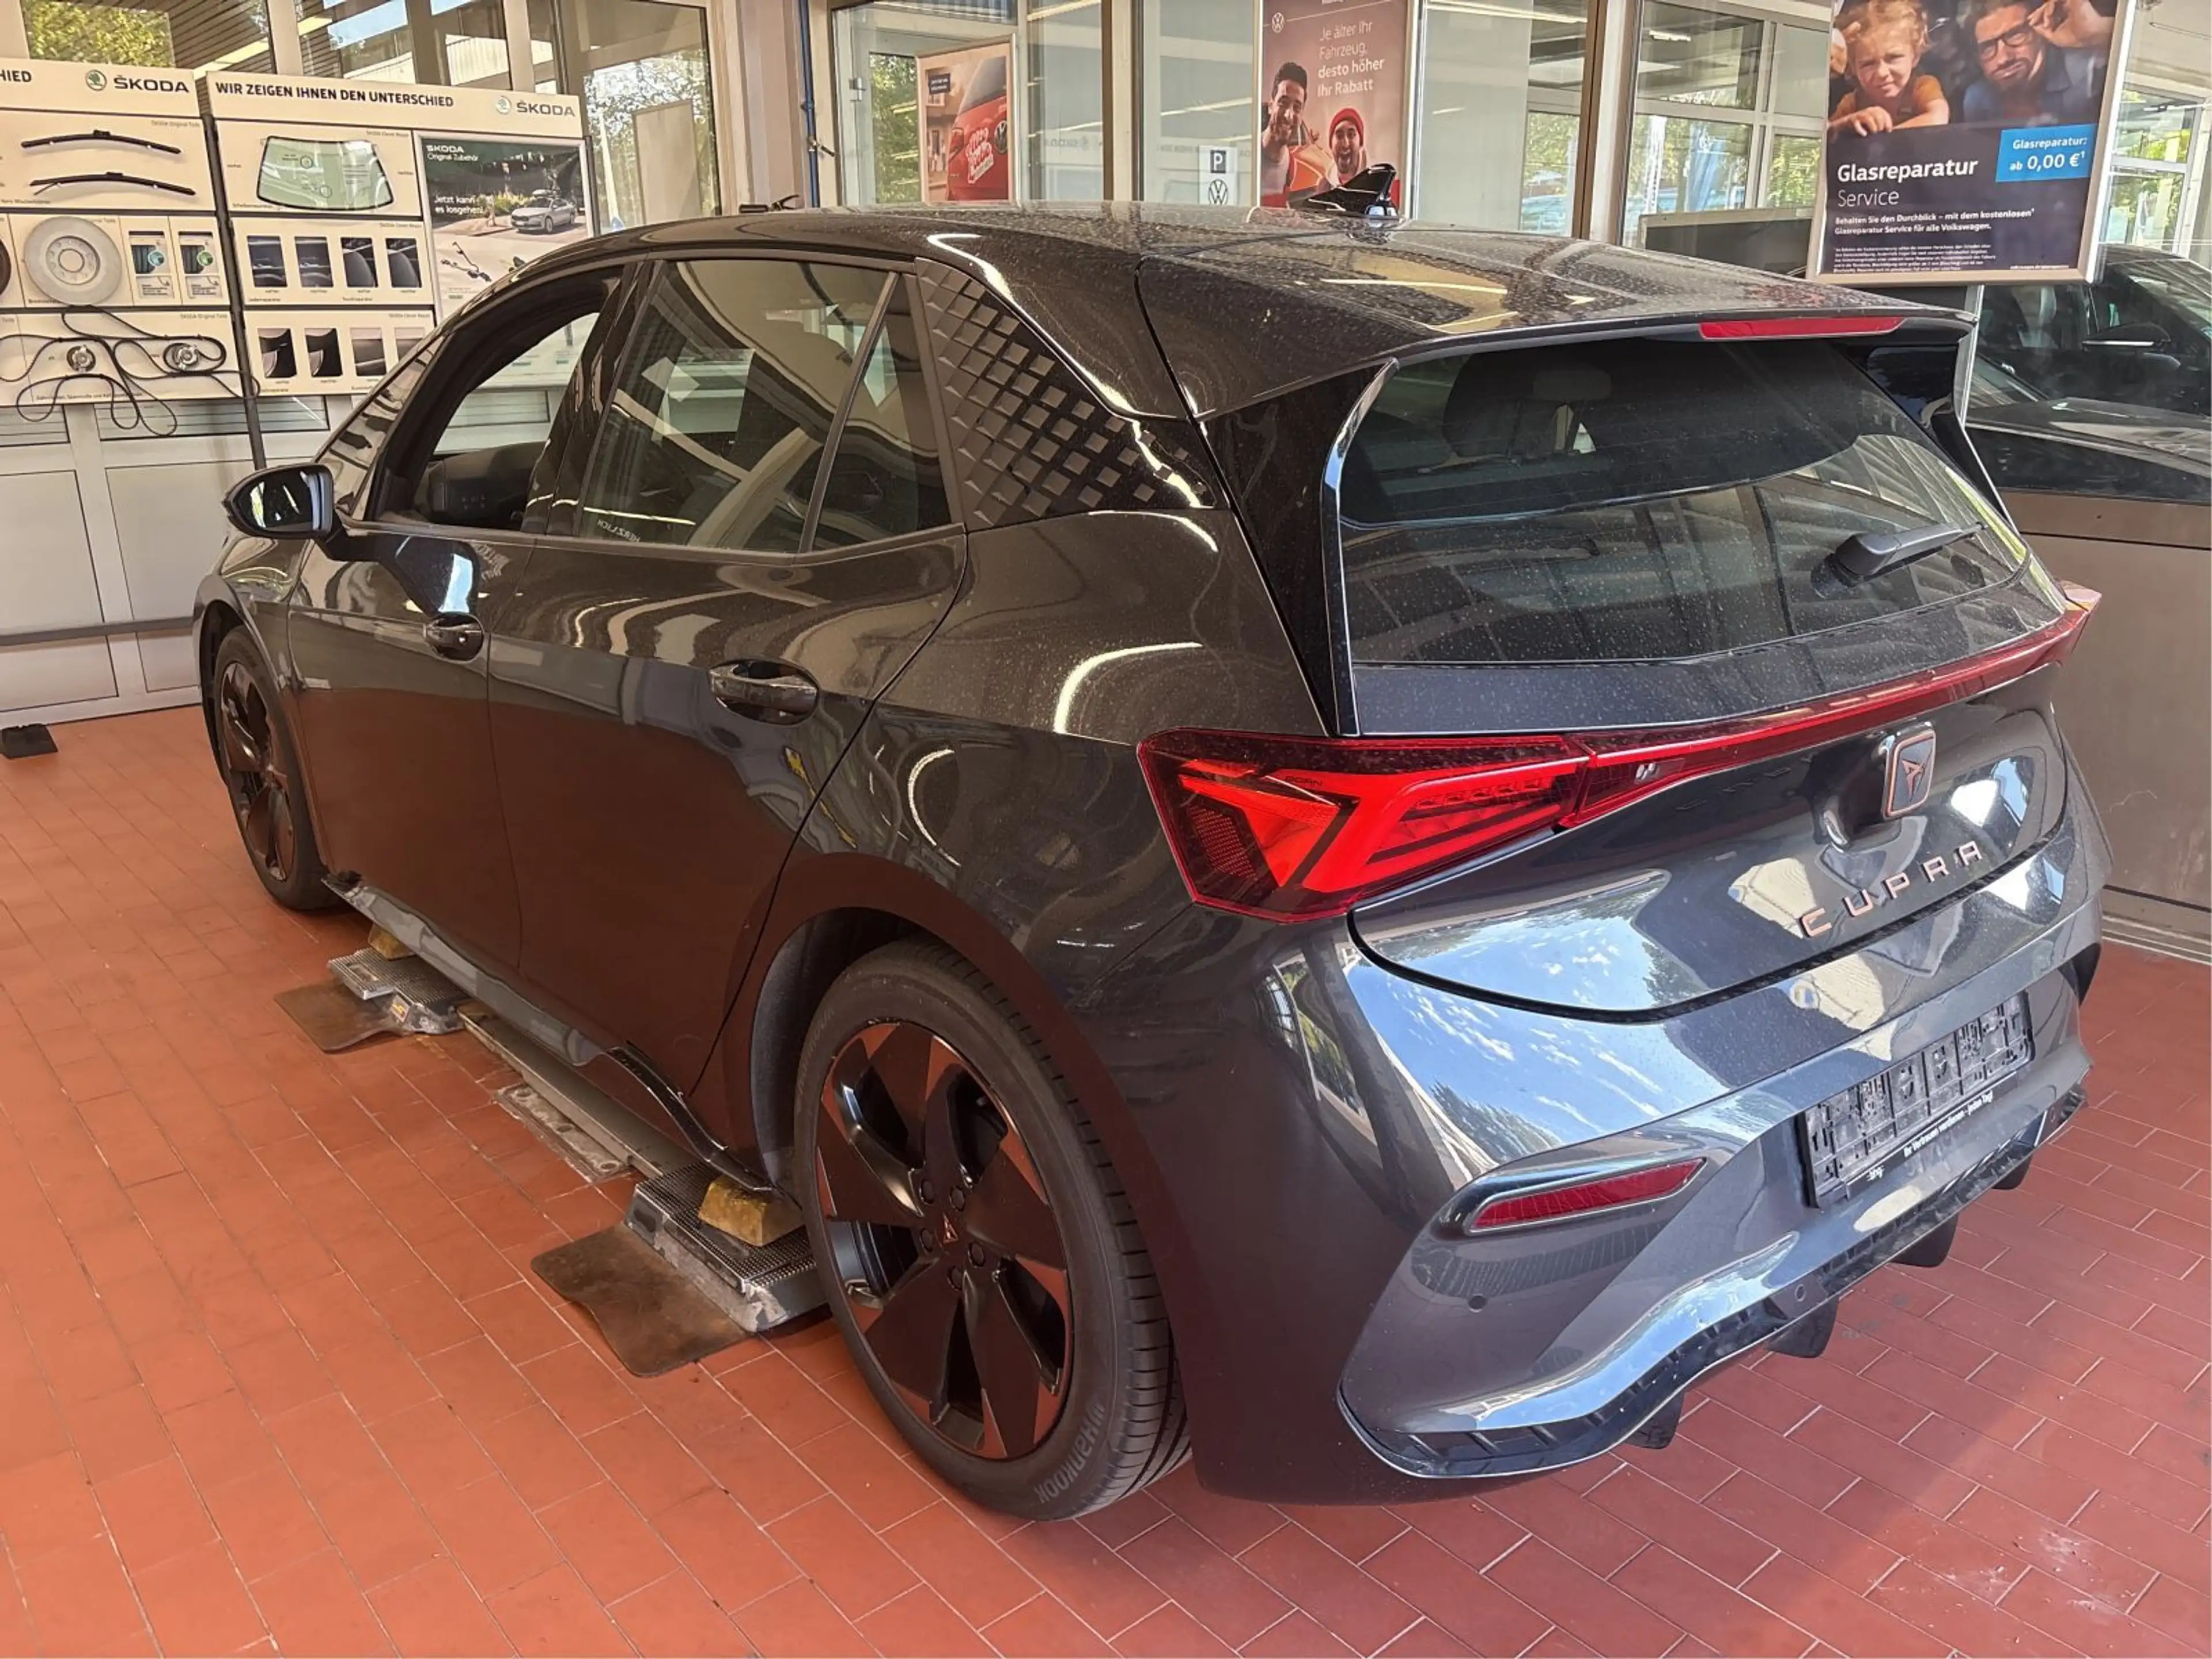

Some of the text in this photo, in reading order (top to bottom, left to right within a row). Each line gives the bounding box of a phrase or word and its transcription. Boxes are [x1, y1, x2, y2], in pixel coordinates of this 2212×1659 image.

[1319, 20, 1373, 41] Je älter Ihr
[1318, 58, 1385, 79] desto höher
[113, 74, 189, 93] ŠKODA
[1317, 79, 1374, 98] Ihr Rabatt
[215, 82, 453, 107] WIR ZEIGEN IHNEN DEN UNTERSCHIED
[517, 100, 575, 117] ŠKODA
[2012, 137, 2088, 150] Glasreparatur:
[1838, 158, 1979, 183] Glasreparatur
[2009, 161, 2023, 171] ab
[2027, 153, 2065, 172] 0,00
[1838, 188, 1899, 207] Service
[1835, 217, 1867, 225] Behalten
[1868, 215, 1880, 224] Sie
[1880, 215, 1895, 223] den
[1896, 213, 1937, 222] Durchblick
[1945, 212, 1959, 220] mit
[1960, 211, 1979, 219] dem
[1884, 225, 1912, 233] Service
[1913, 224, 1925, 232] für
[1926, 224, 1940, 232] alle
[1800, 840, 1982, 938] CUPRA
